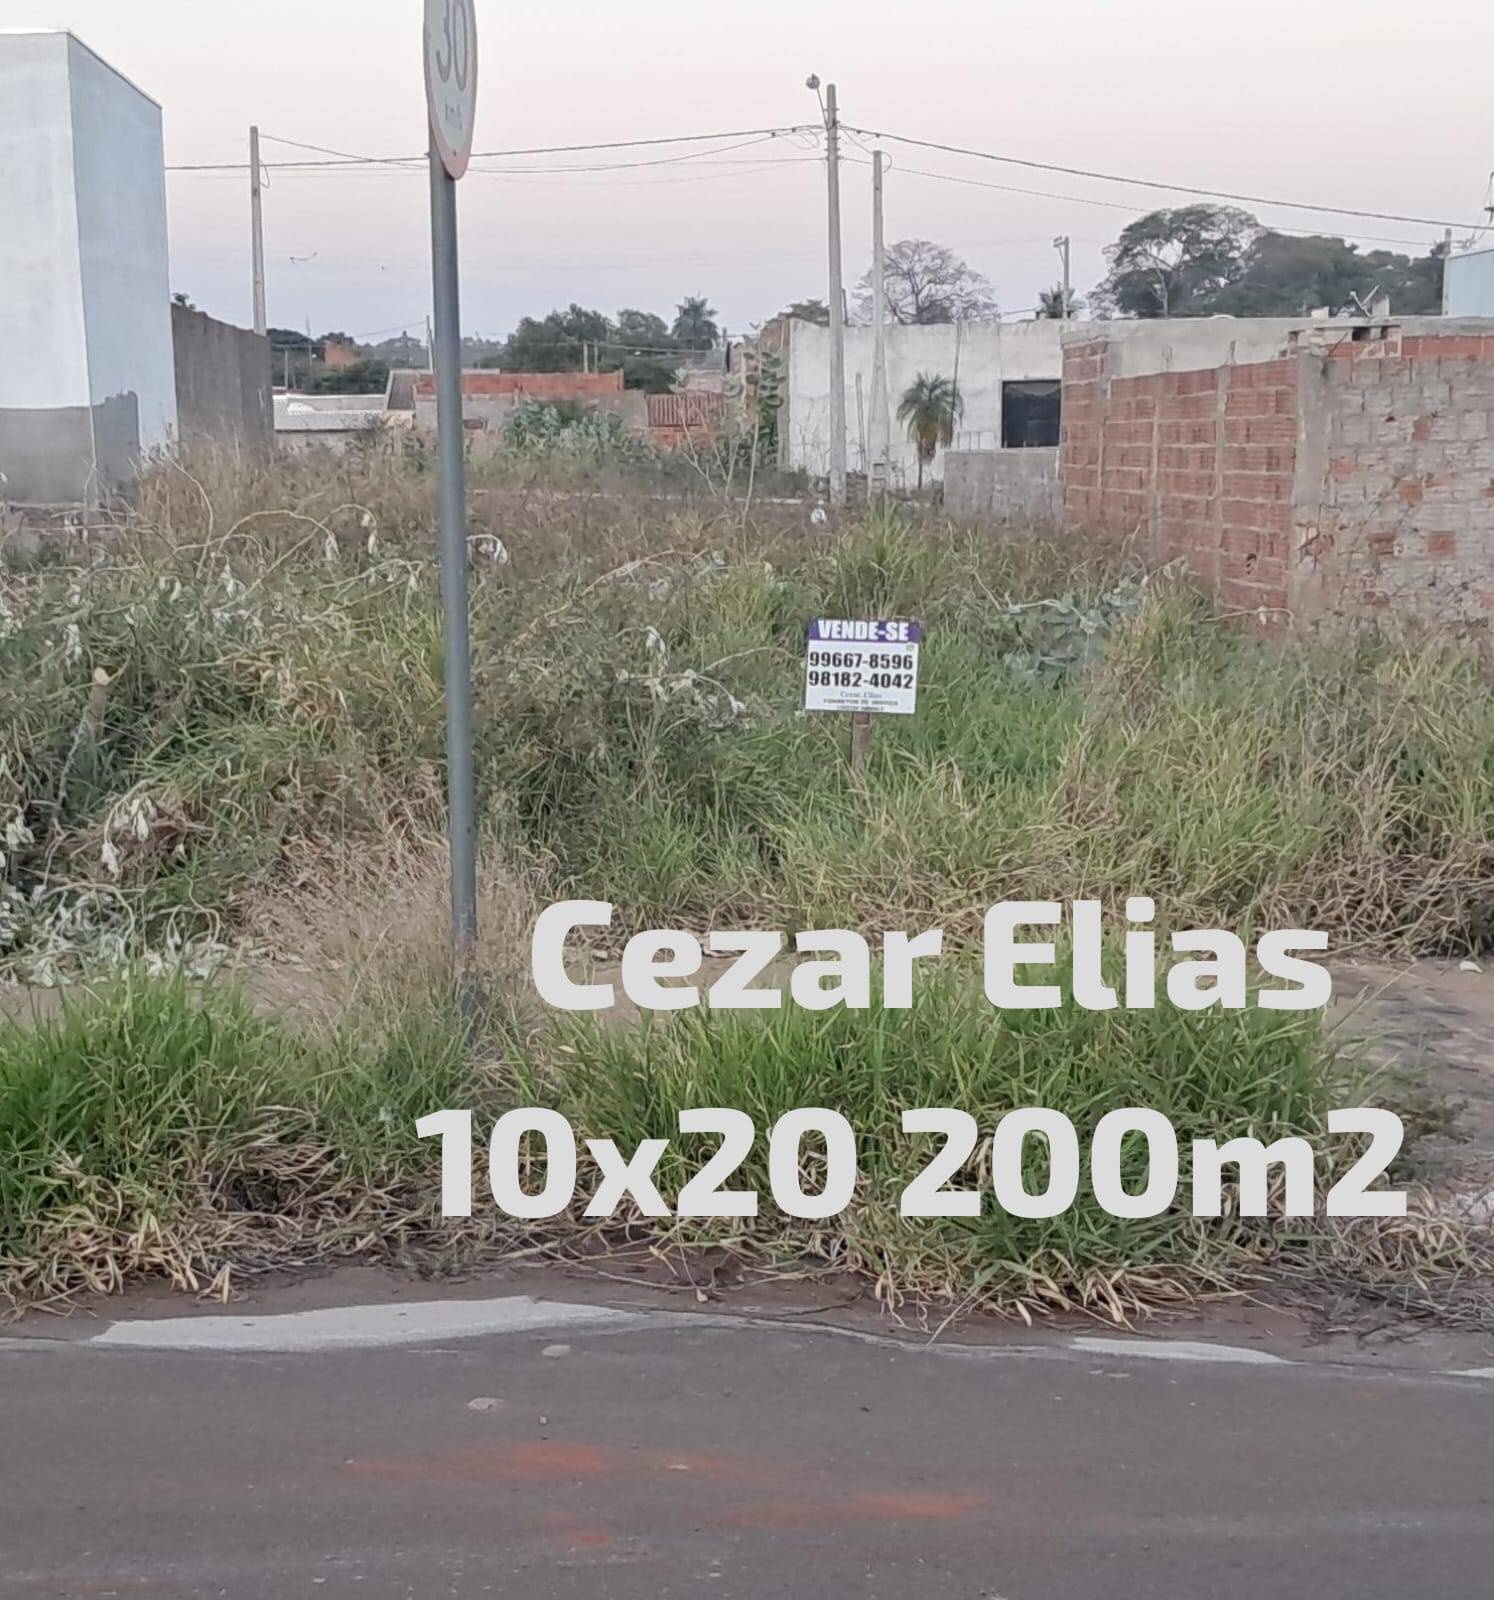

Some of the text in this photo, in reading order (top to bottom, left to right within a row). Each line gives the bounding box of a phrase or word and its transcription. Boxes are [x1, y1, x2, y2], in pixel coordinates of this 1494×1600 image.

[436, 0, 467, 91] 30
[817, 619, 909, 641] VENDE-SE
[809, 652, 913, 670] 99667-8596
[808, 671, 914, 689] 98182-4042
